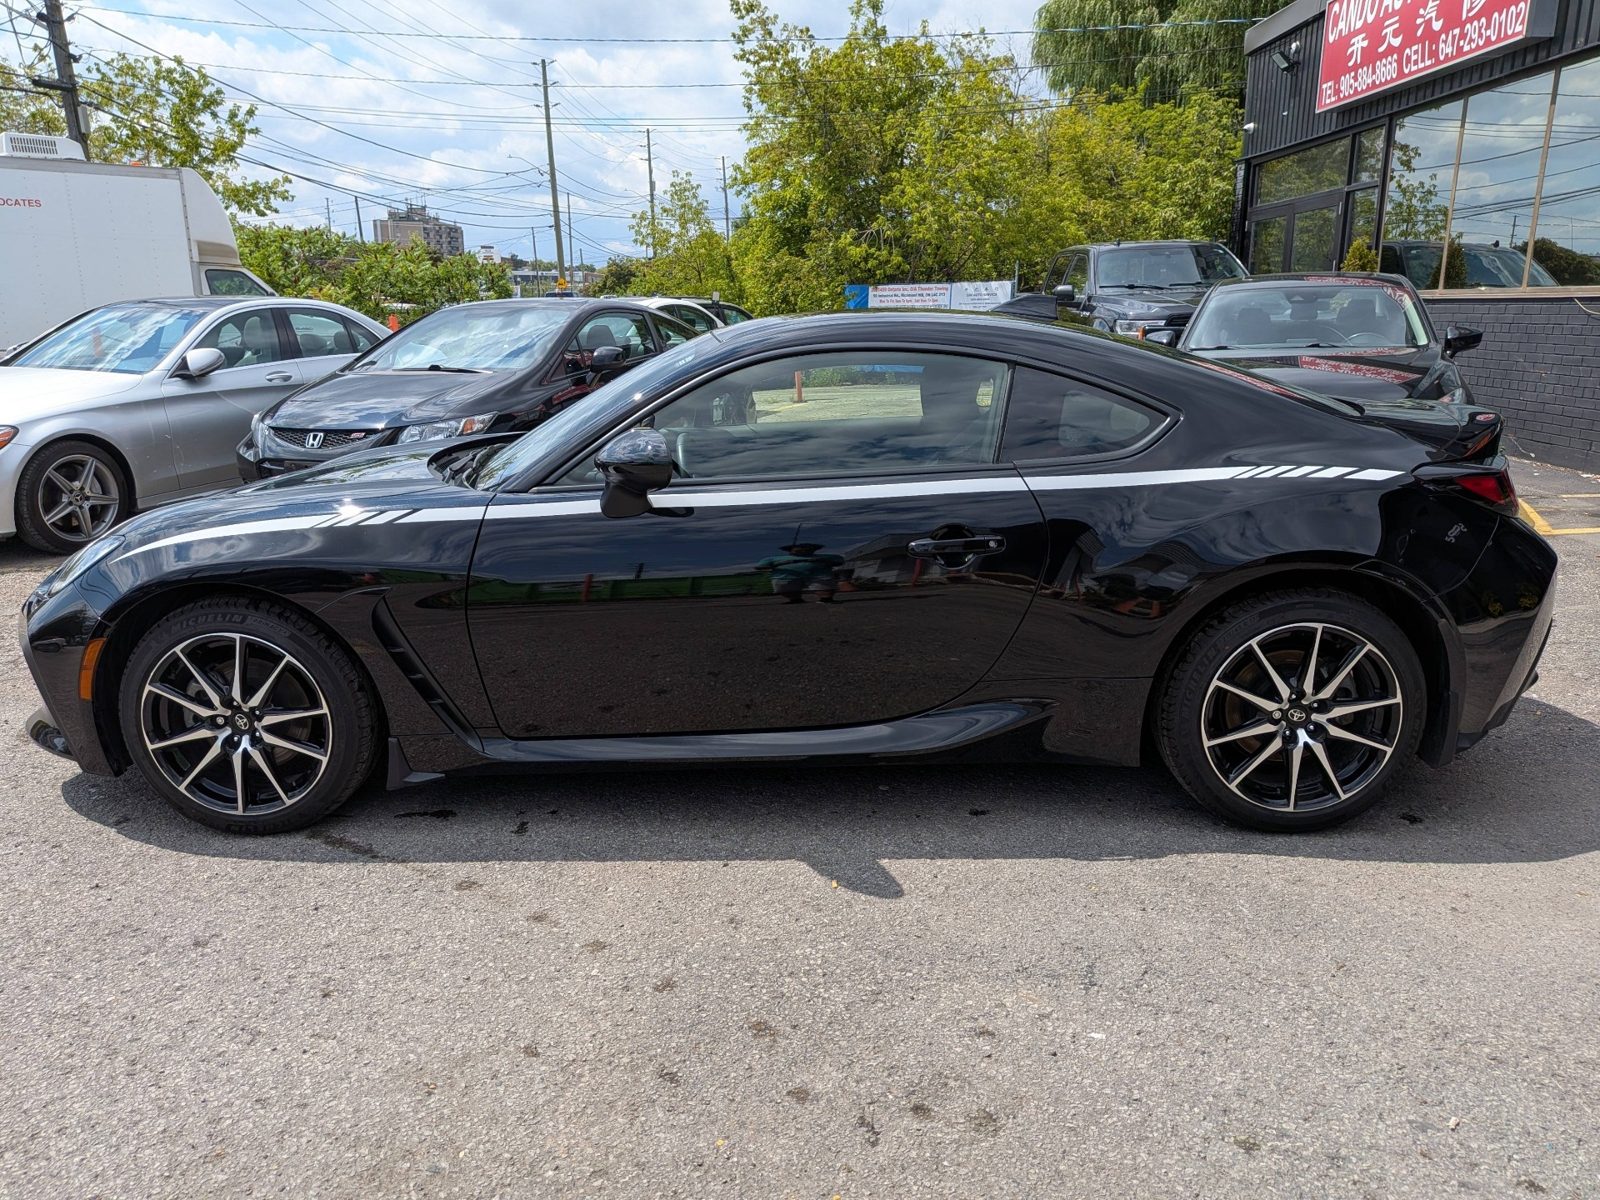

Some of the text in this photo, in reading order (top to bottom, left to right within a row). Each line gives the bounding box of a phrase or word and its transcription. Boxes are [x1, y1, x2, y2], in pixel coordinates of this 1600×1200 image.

[1329, 0, 1379, 43] CANDO
[1322, 81, 1339, 106] TEL:
[1340, 53, 1398, 98] 905-884-8666
[1403, 40, 1436, 74] CELL:
[1438, 1, 1526, 61] 647-293-0102
[171, 613, 244, 634] MICHELIN
